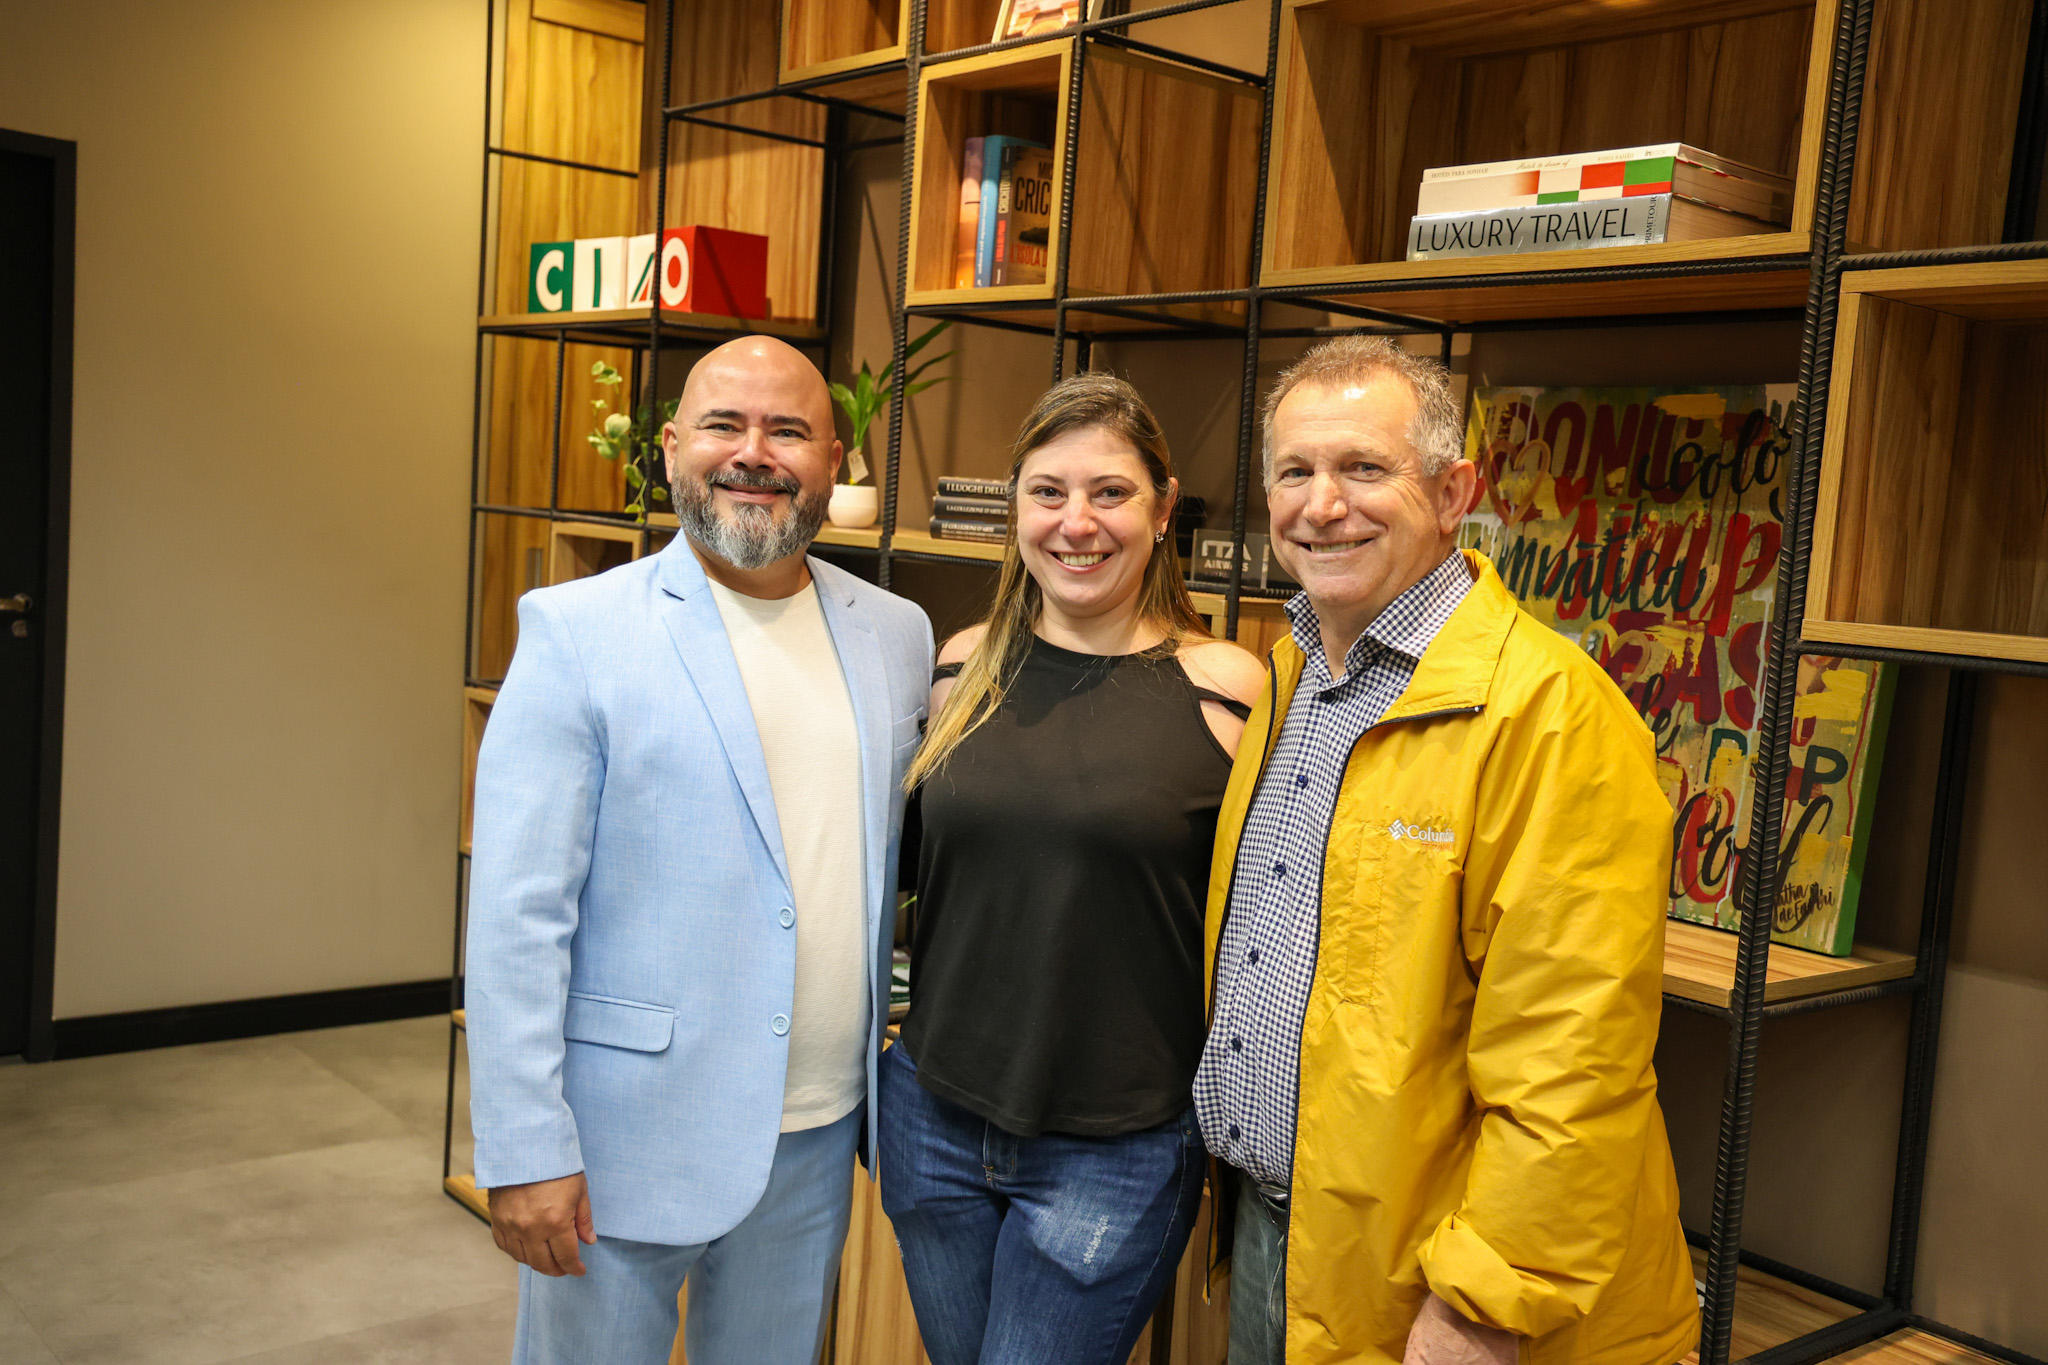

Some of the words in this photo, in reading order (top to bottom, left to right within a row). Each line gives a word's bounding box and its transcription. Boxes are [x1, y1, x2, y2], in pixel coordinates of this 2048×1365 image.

[1015, 177, 1051, 215] CRIC
[1416, 216, 1524, 252] LUXURY
[1530, 207, 1636, 244] TRAVEL
[985, 486, 1007, 495] DELL
[1204, 559, 1249, 572] AIRWS
